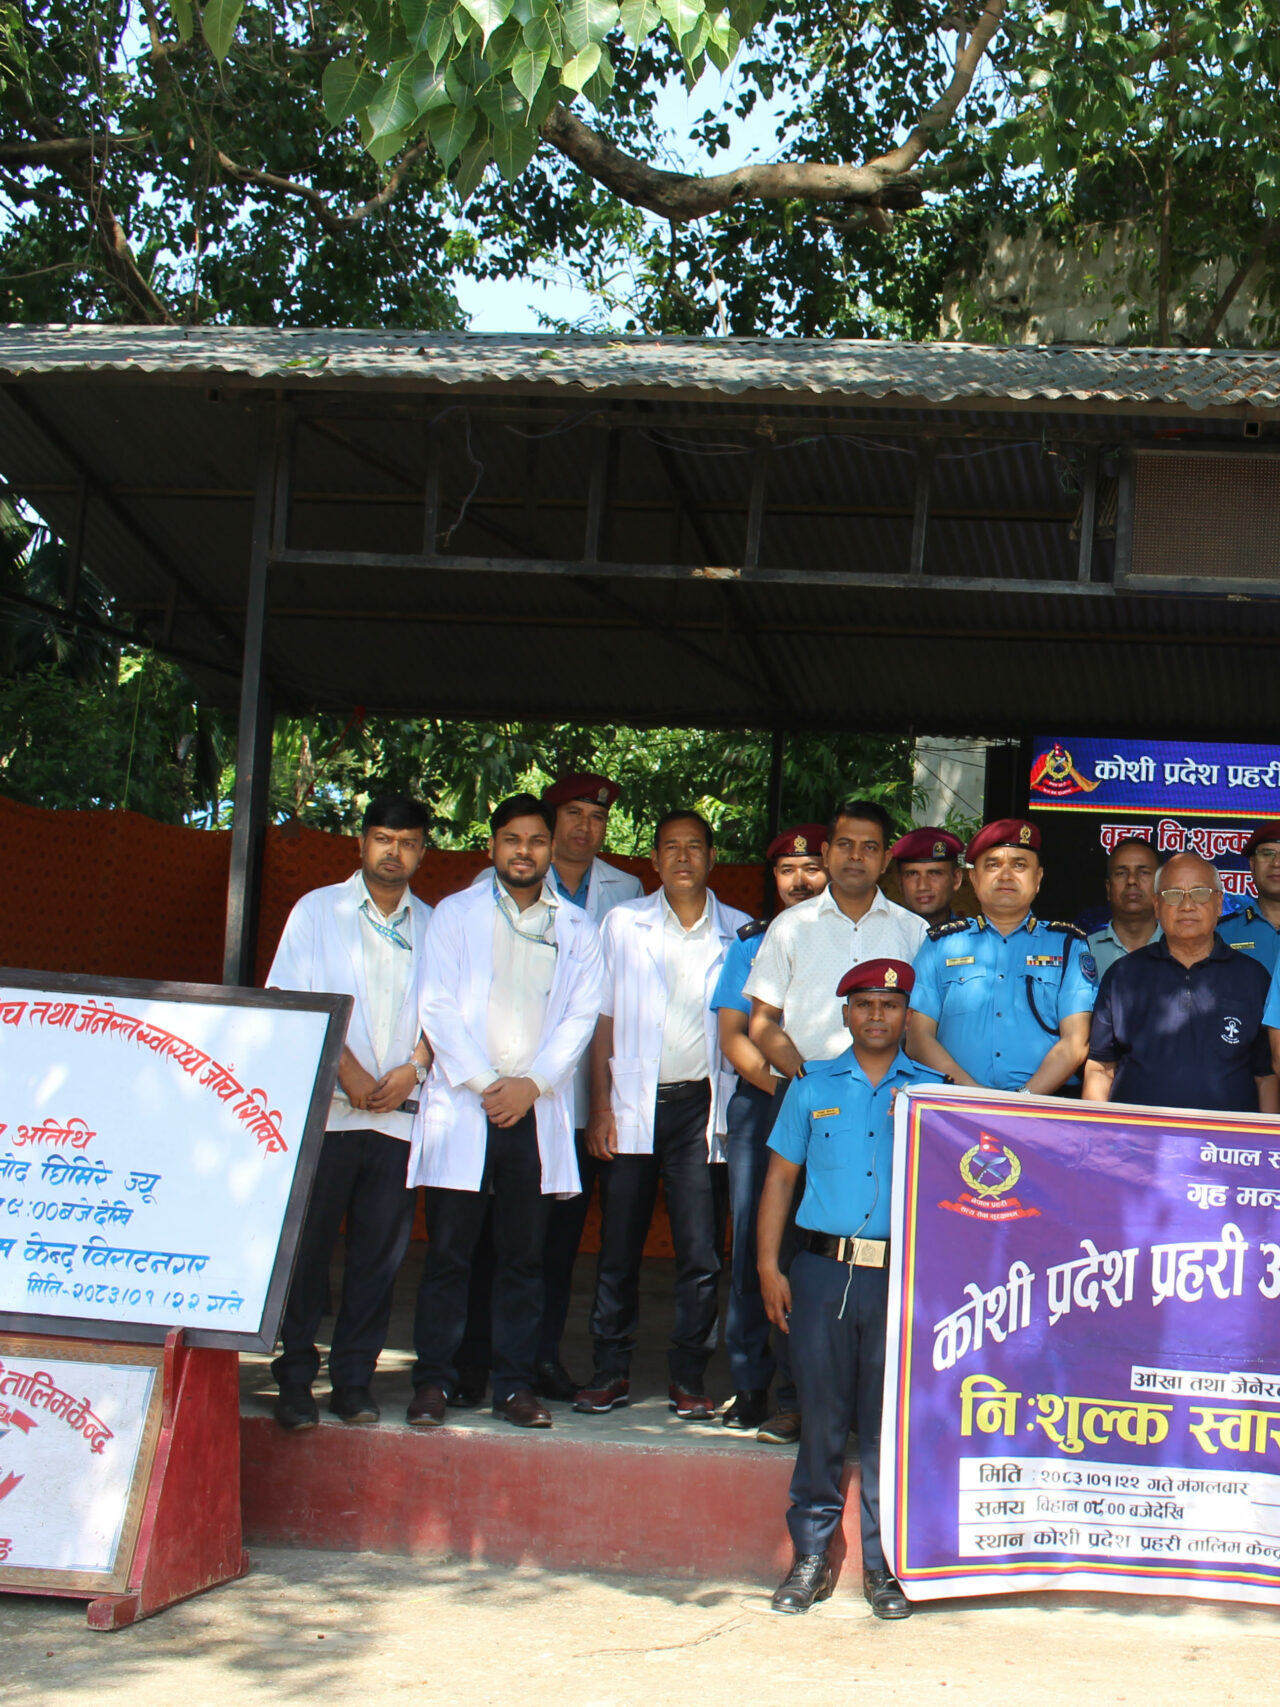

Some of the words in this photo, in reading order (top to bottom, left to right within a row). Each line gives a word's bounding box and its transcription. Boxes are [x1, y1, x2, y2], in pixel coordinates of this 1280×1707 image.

[1094, 754, 1157, 783] कोशी
[1164, 757, 1220, 786] प्रदेश
[29, 1001, 80, 1030] तथा
[74, 999, 144, 1043] जेनेरल
[137, 1023, 211, 1077] स्वास्थ्य
[199, 1060, 245, 1103] जाँच
[232, 1088, 288, 1160] शिविर
[12, 1118, 97, 1151] अतिथि
[1200, 1142, 1262, 1166] नेपाल
[41, 1154, 113, 1190] घिमिरे
[125, 1171, 162, 1205] ज्यू
[1187, 1183, 1230, 1210] गृह
[24, 1232, 78, 1273] केन्द्र
[82, 1236, 210, 1275] विराटनगर
[205, 1290, 245, 1314] गते
[932, 1260, 1036, 1372] कोशी
[1046, 1238, 1140, 1327] प्रदेश
[1150, 1221, 1249, 1307] प्रहरी
[1189, 1377, 1227, 1393] तथा
[979, 1463, 1023, 1484] मिति
[1147, 1475, 1173, 1493] गते
[975, 1499, 1025, 1517] समय
[974, 1532, 1024, 1551] स्थान
[1033, 1526, 1081, 1547] कोशी
[1087, 1529, 1130, 1549] प्रदेश
[1139, 1533, 1181, 1552] प्रहरी
[1187, 1536, 1242, 1555] तालिम
